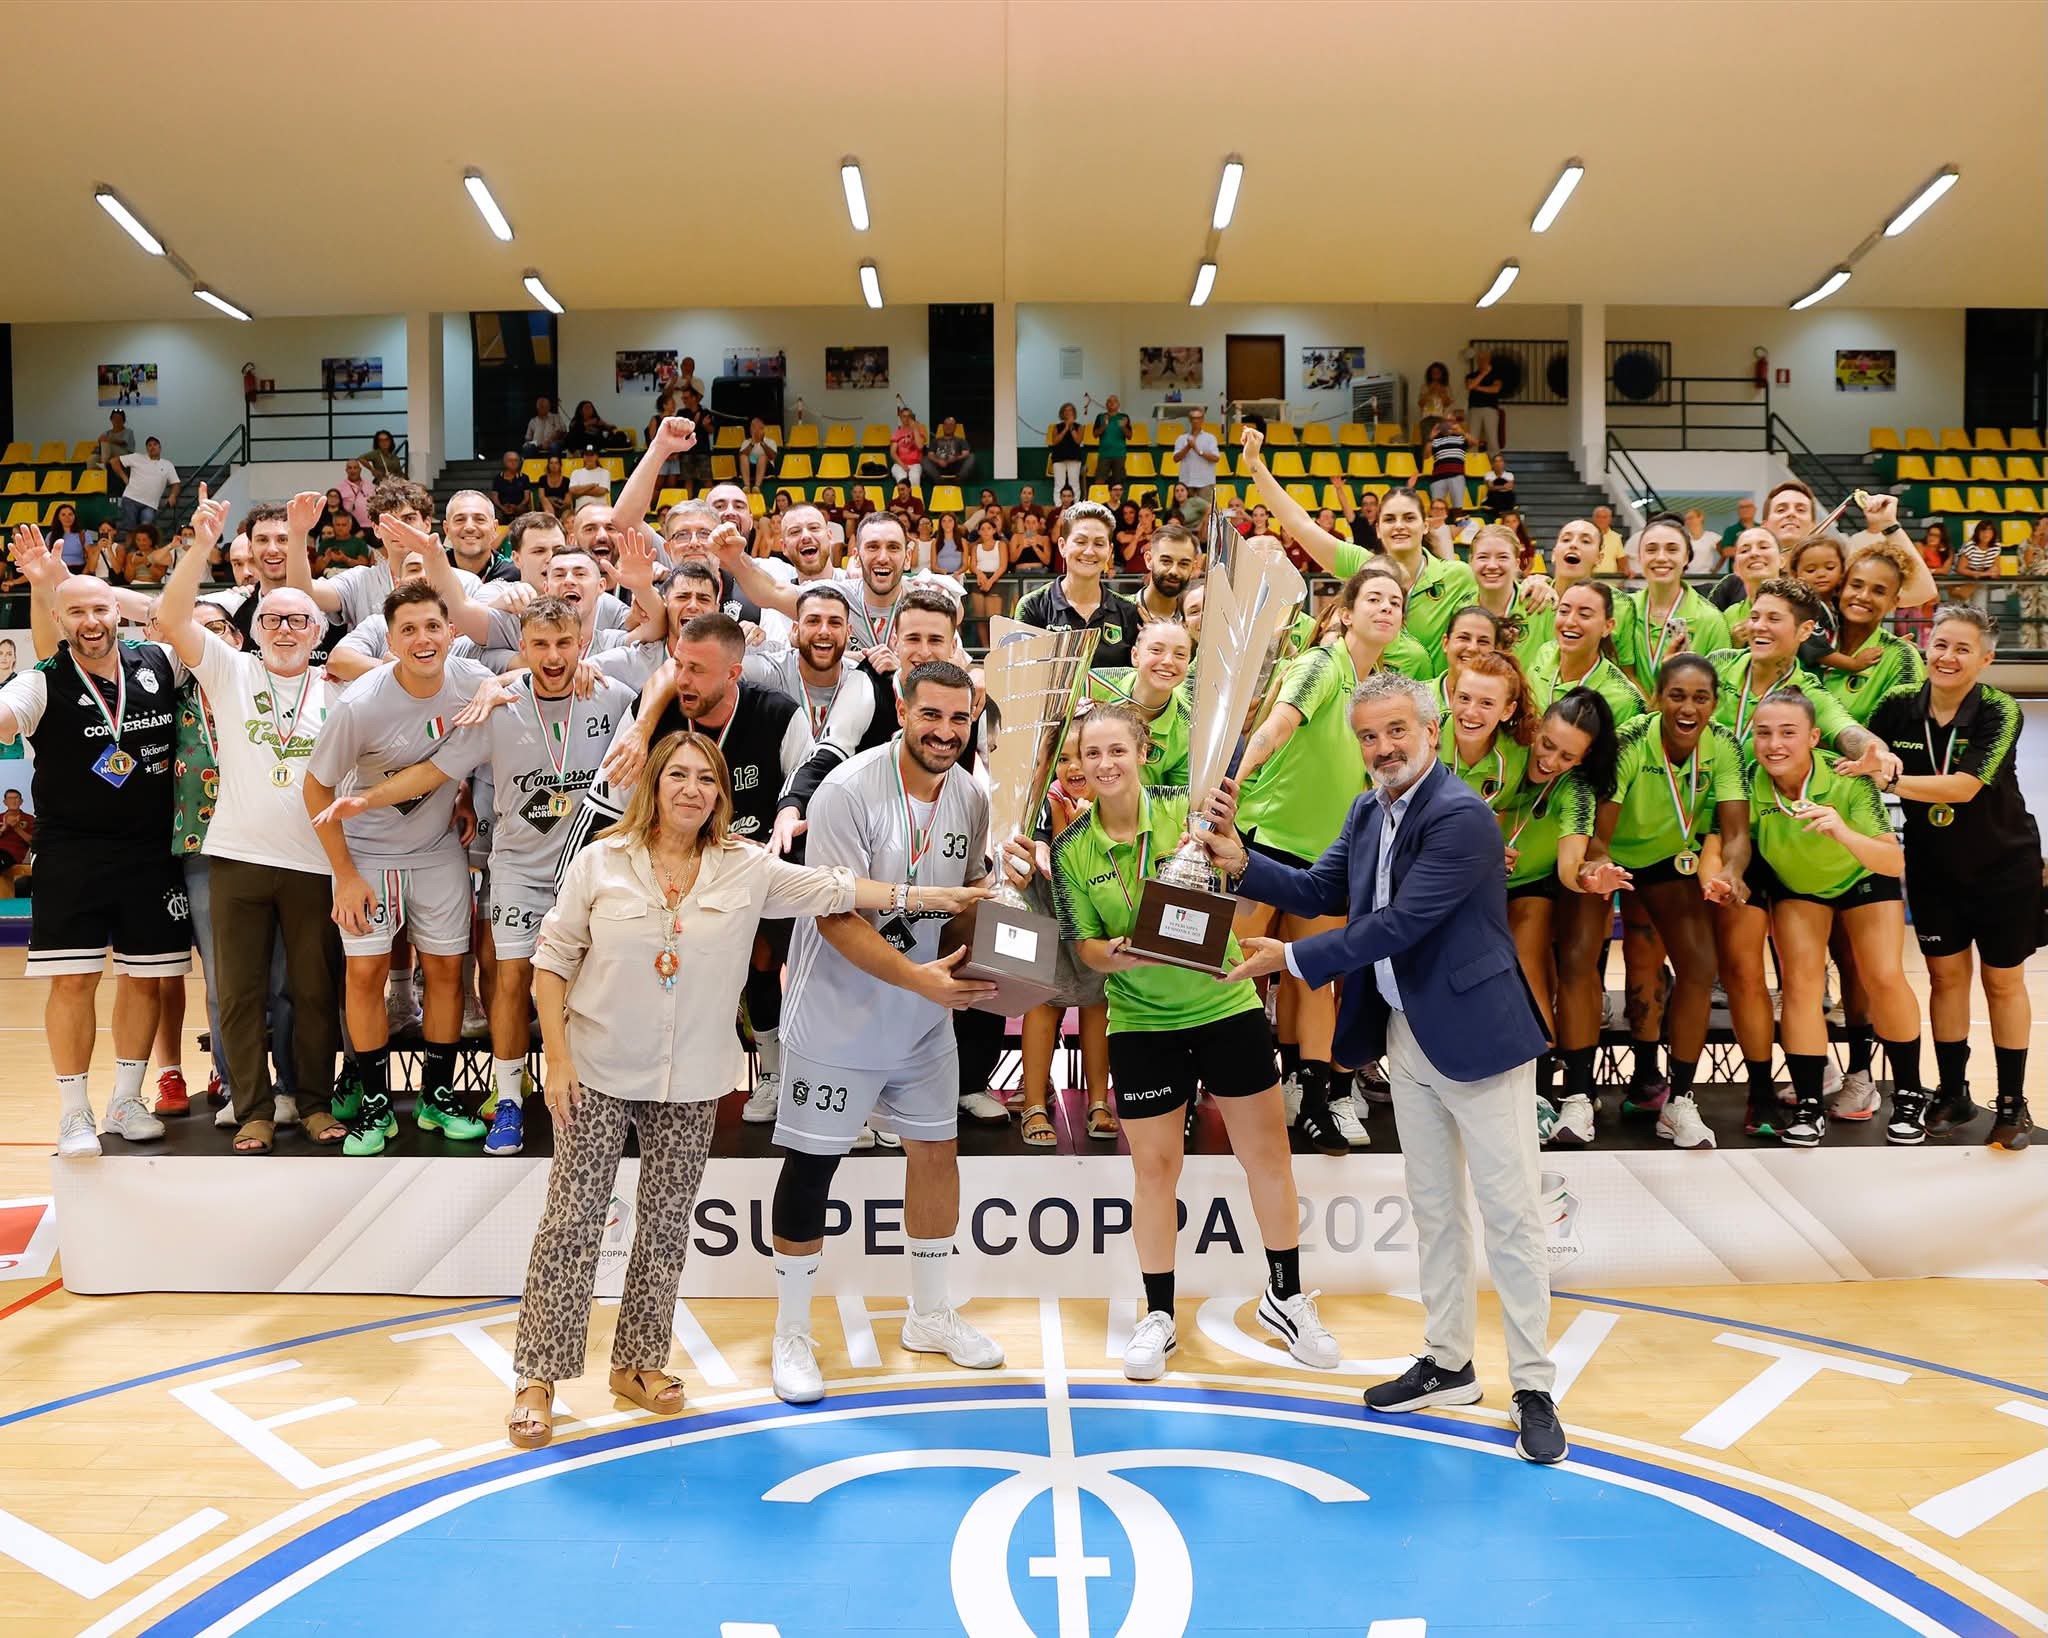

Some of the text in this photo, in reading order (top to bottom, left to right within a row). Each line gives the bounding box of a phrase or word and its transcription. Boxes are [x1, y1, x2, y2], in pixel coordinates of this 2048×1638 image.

[84, 713, 173, 738] CONERSANO
[586, 713, 611, 739] 24
[734, 765, 759, 791] 12
[528, 810, 553, 819] NORB
[533, 804, 549, 812] RADI
[942, 832, 968, 859] 33
[505, 906, 533, 929] 24
[815, 1084, 848, 1113] 33
[1123, 1086, 1172, 1101] GIVOVA
[693, 1195, 1411, 1257] SUPECOPA 202
[912, 1251, 948, 1259] adidas
[1423, 1376, 1440, 1392] EA7
